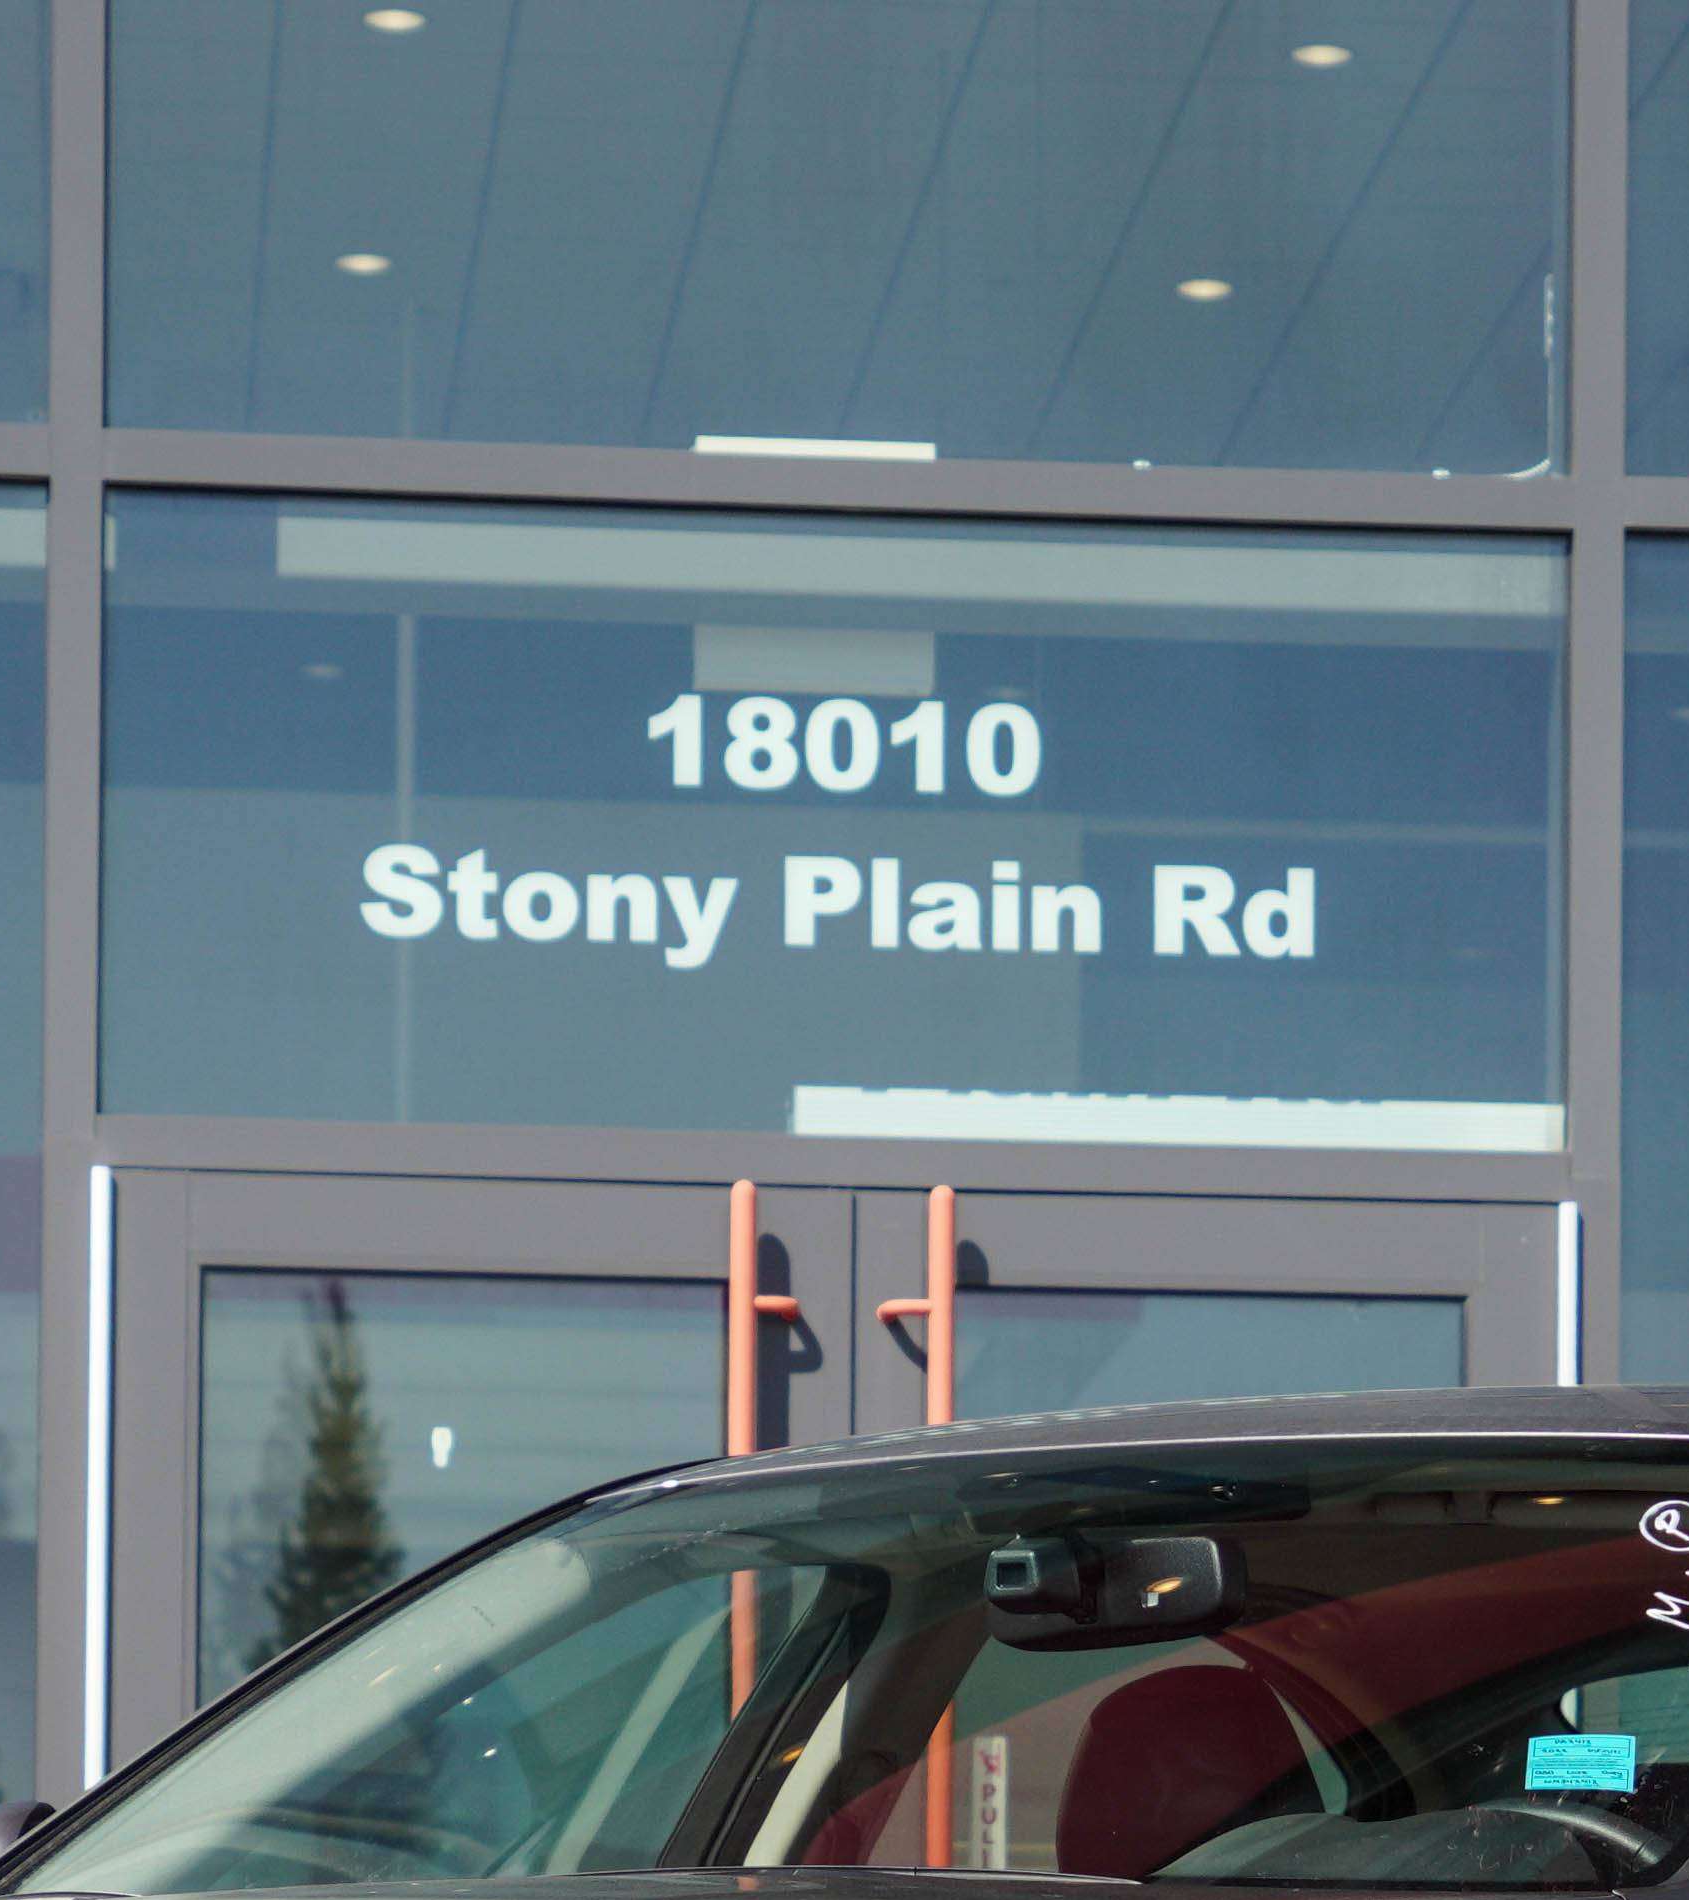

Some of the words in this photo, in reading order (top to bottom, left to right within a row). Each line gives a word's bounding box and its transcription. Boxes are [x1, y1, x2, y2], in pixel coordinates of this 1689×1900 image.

[647, 694, 1041, 796] 18010
[360, 844, 738, 969] Stony
[784, 855, 1102, 954] Plain
[1153, 864, 1315, 958] Rd
